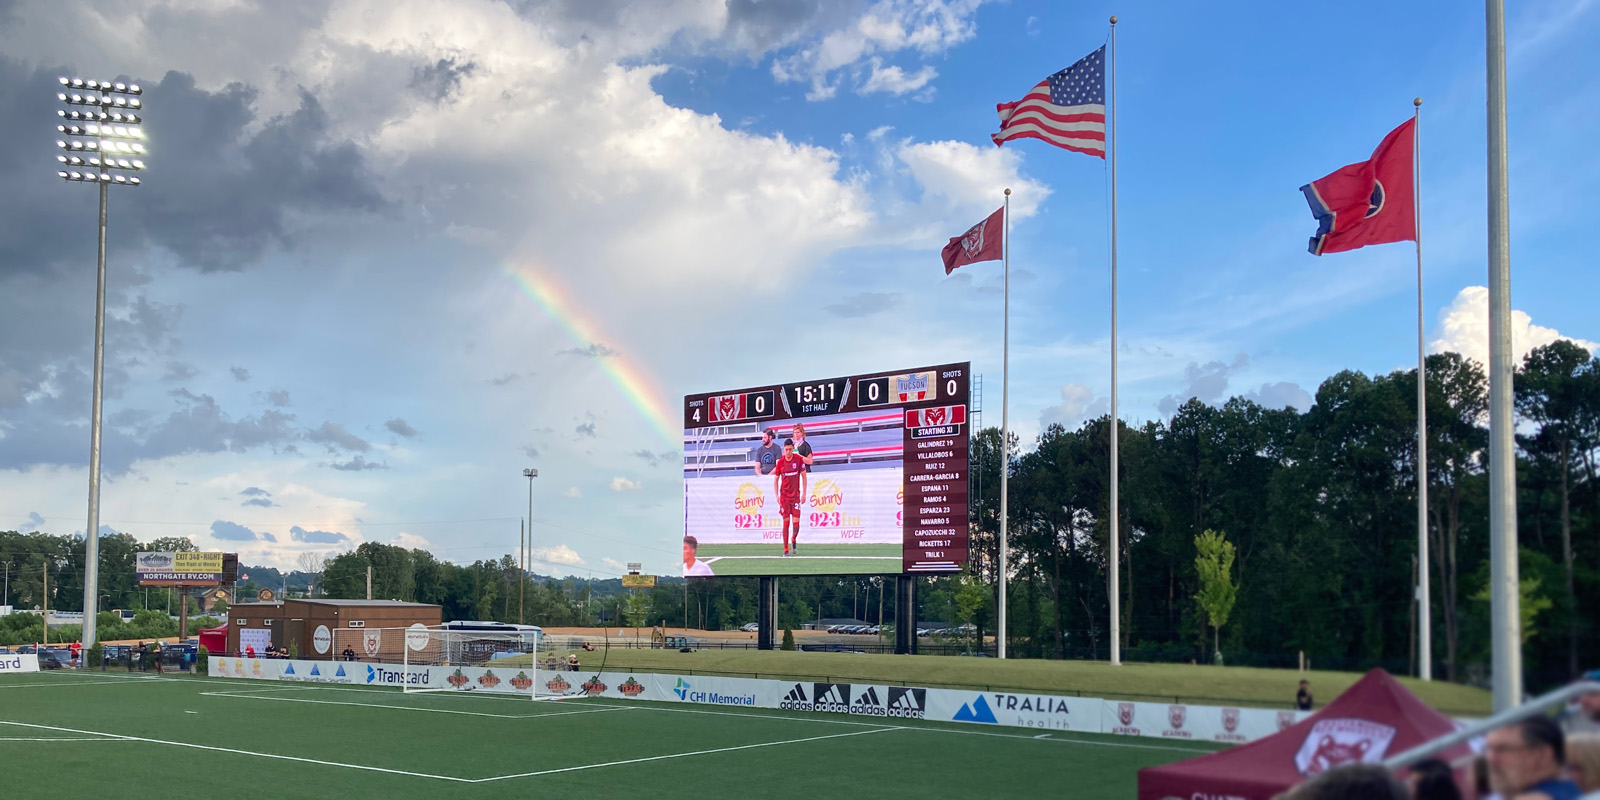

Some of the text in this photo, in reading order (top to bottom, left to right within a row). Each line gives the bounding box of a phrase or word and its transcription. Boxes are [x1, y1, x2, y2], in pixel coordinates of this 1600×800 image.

[942, 370, 962, 379] SHOTS
[868, 382, 879, 401] 0
[900, 380, 925, 390] TUCSON
[946, 379, 957, 396] 0
[794, 383, 835, 404] 15:11
[755, 396, 765, 413] 0
[814, 402, 828, 411] HALF
[692, 408, 701, 422] 4
[918, 426, 946, 436] STARTING
[918, 440, 945, 448] GALINDREZ
[910, 474, 954, 482] CARRERA-GARCIA
[734, 496, 765, 510] Sunny
[810, 492, 843, 508] Sunny
[764, 513, 780, 528] fm
[842, 512, 861, 526] fm
[840, 530, 864, 539] WDEF
[377, 668, 429, 684] Transcard
[690, 692, 756, 705] CHI Memorial
[780, 700, 812, 710] adidas
[995, 694, 1069, 714] TRALIA
[815, 702, 848, 713] adidas
[851, 704, 886, 715] adidas
[888, 707, 924, 718] adidas
[1018, 716, 1069, 729] health
[1112, 727, 1140, 735] ACADEMY
